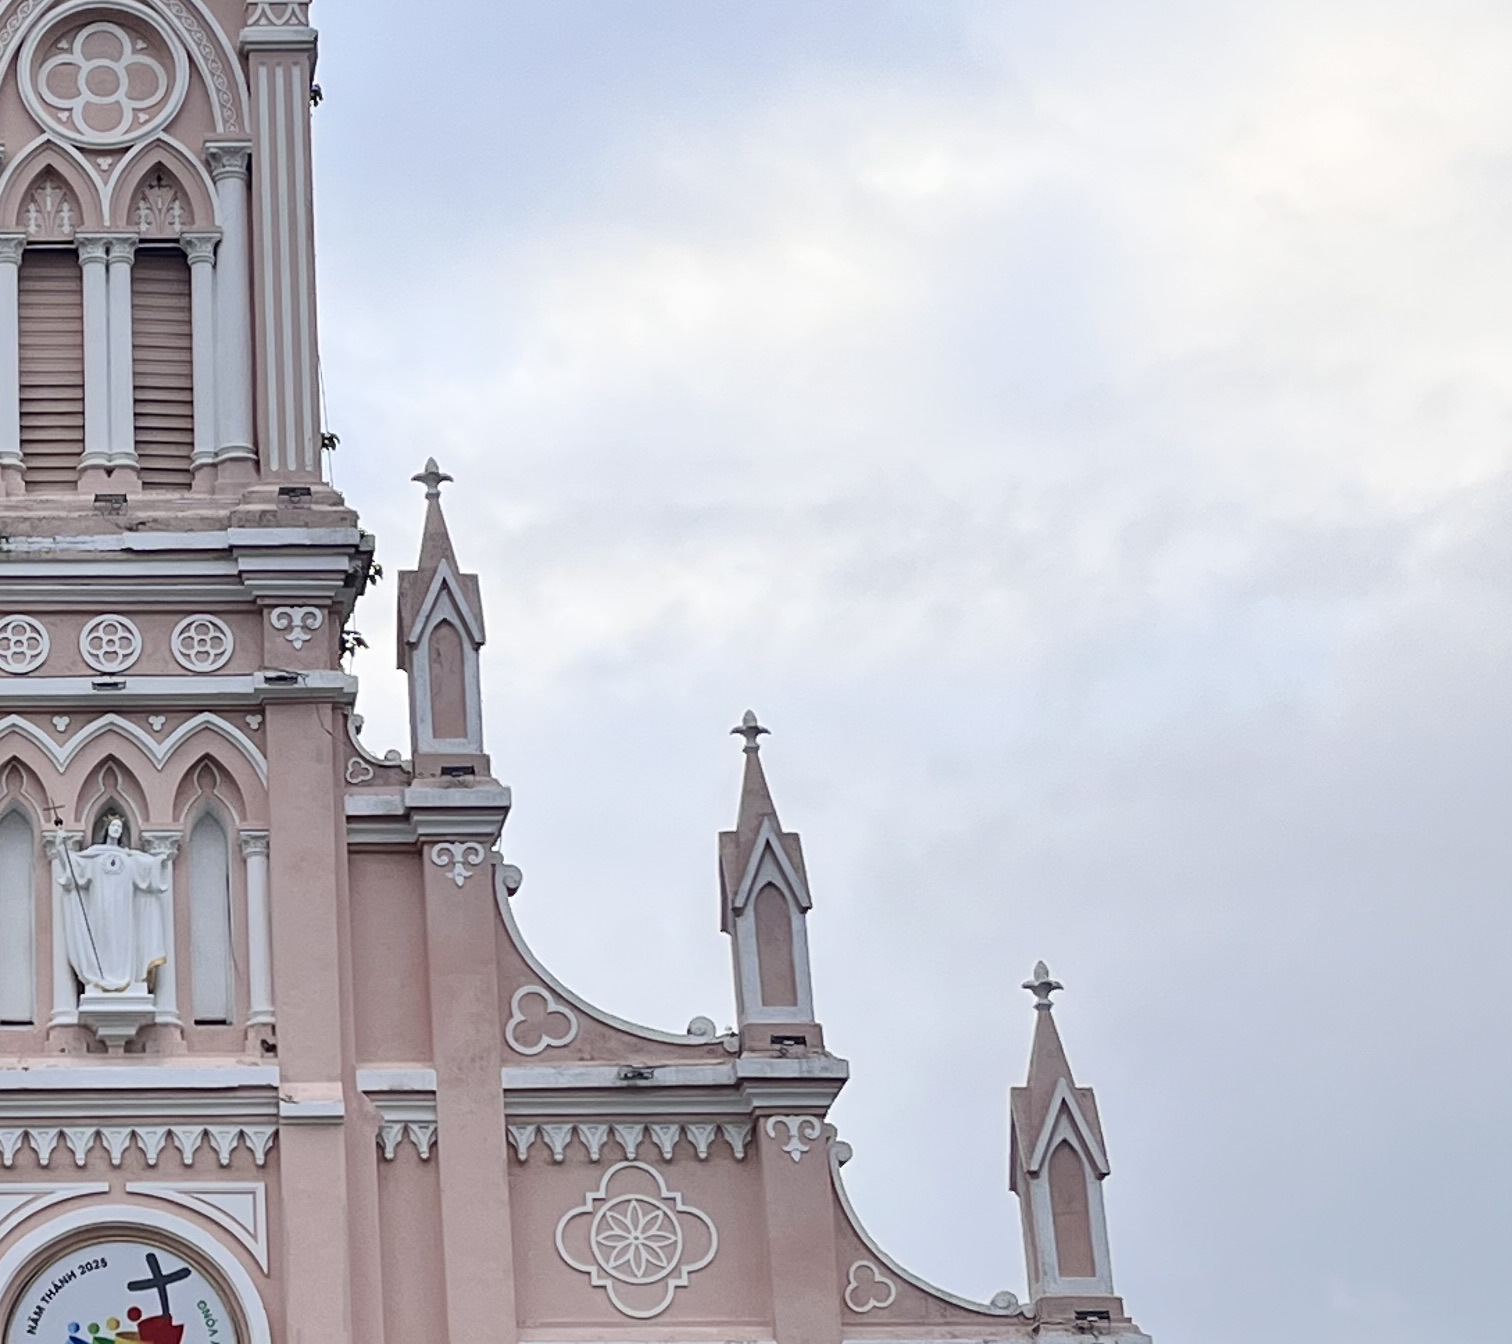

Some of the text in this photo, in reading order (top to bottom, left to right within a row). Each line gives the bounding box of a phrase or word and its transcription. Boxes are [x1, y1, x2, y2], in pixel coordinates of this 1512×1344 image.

[26, 1257, 108, 1335] NĂM THÁNH 2025
